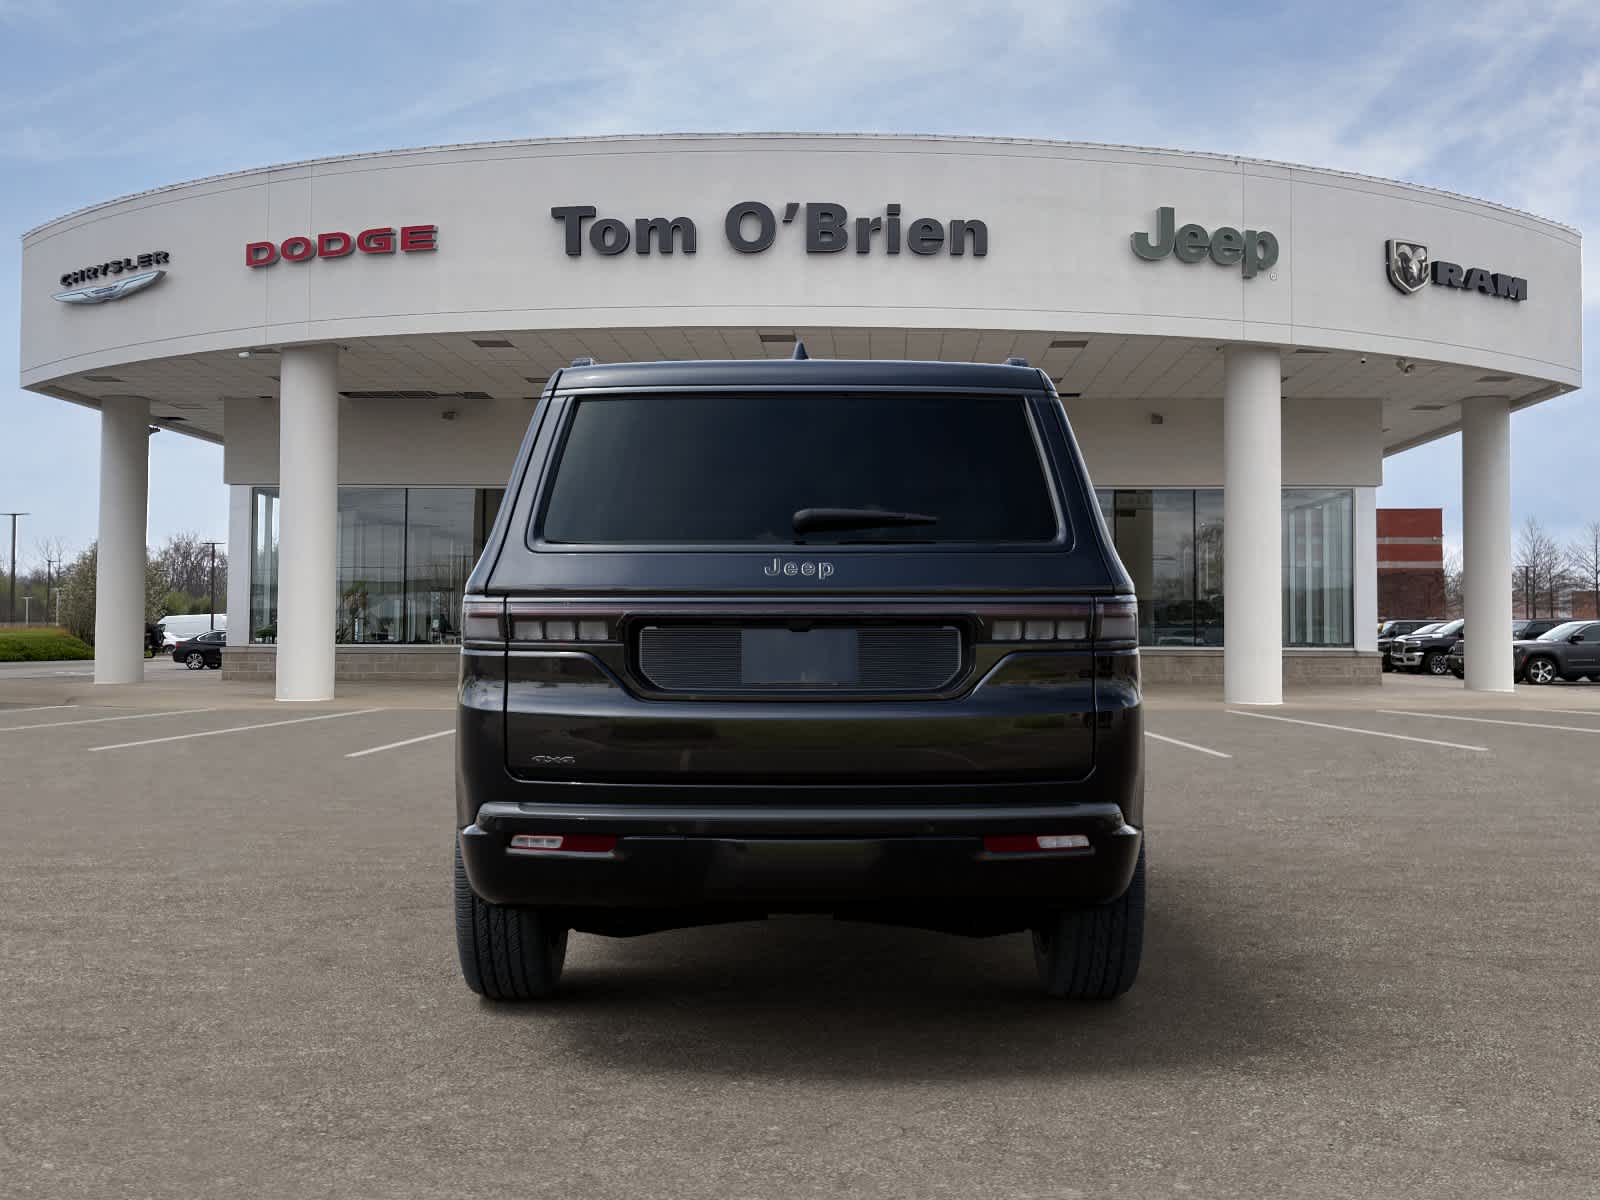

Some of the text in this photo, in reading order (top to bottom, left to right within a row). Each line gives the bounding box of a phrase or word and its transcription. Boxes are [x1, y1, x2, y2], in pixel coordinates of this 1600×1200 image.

[245, 224, 438, 269] DODGE
[551, 201, 988, 256] Tom O'Brien
[1130, 206, 1280, 278] Jeep
[60, 250, 170, 287] CHRYSLER
[1431, 260, 1528, 302] RAM
[763, 557, 834, 580] Jeep
